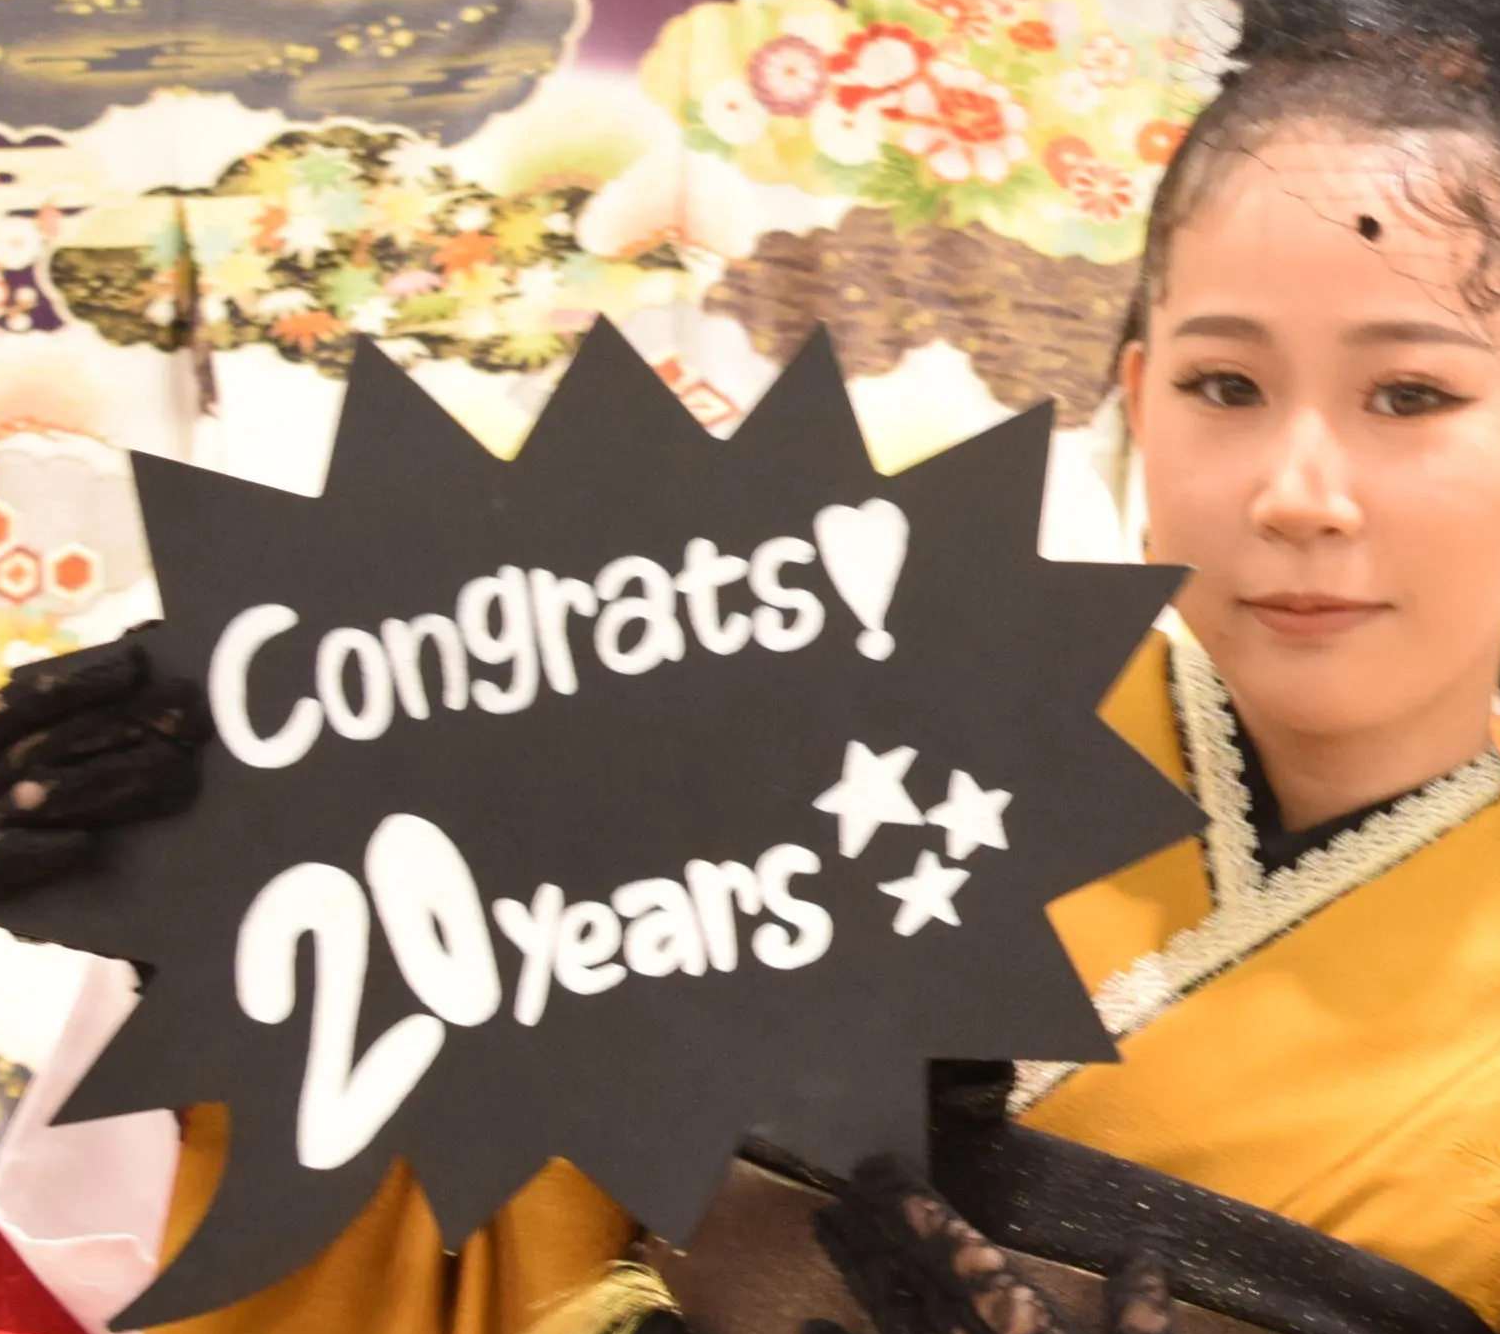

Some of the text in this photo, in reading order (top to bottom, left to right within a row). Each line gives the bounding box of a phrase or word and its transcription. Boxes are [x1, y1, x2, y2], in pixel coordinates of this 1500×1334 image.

[208, 498, 909, 769] Congrats!
[235, 813, 833, 1170] 20 years
